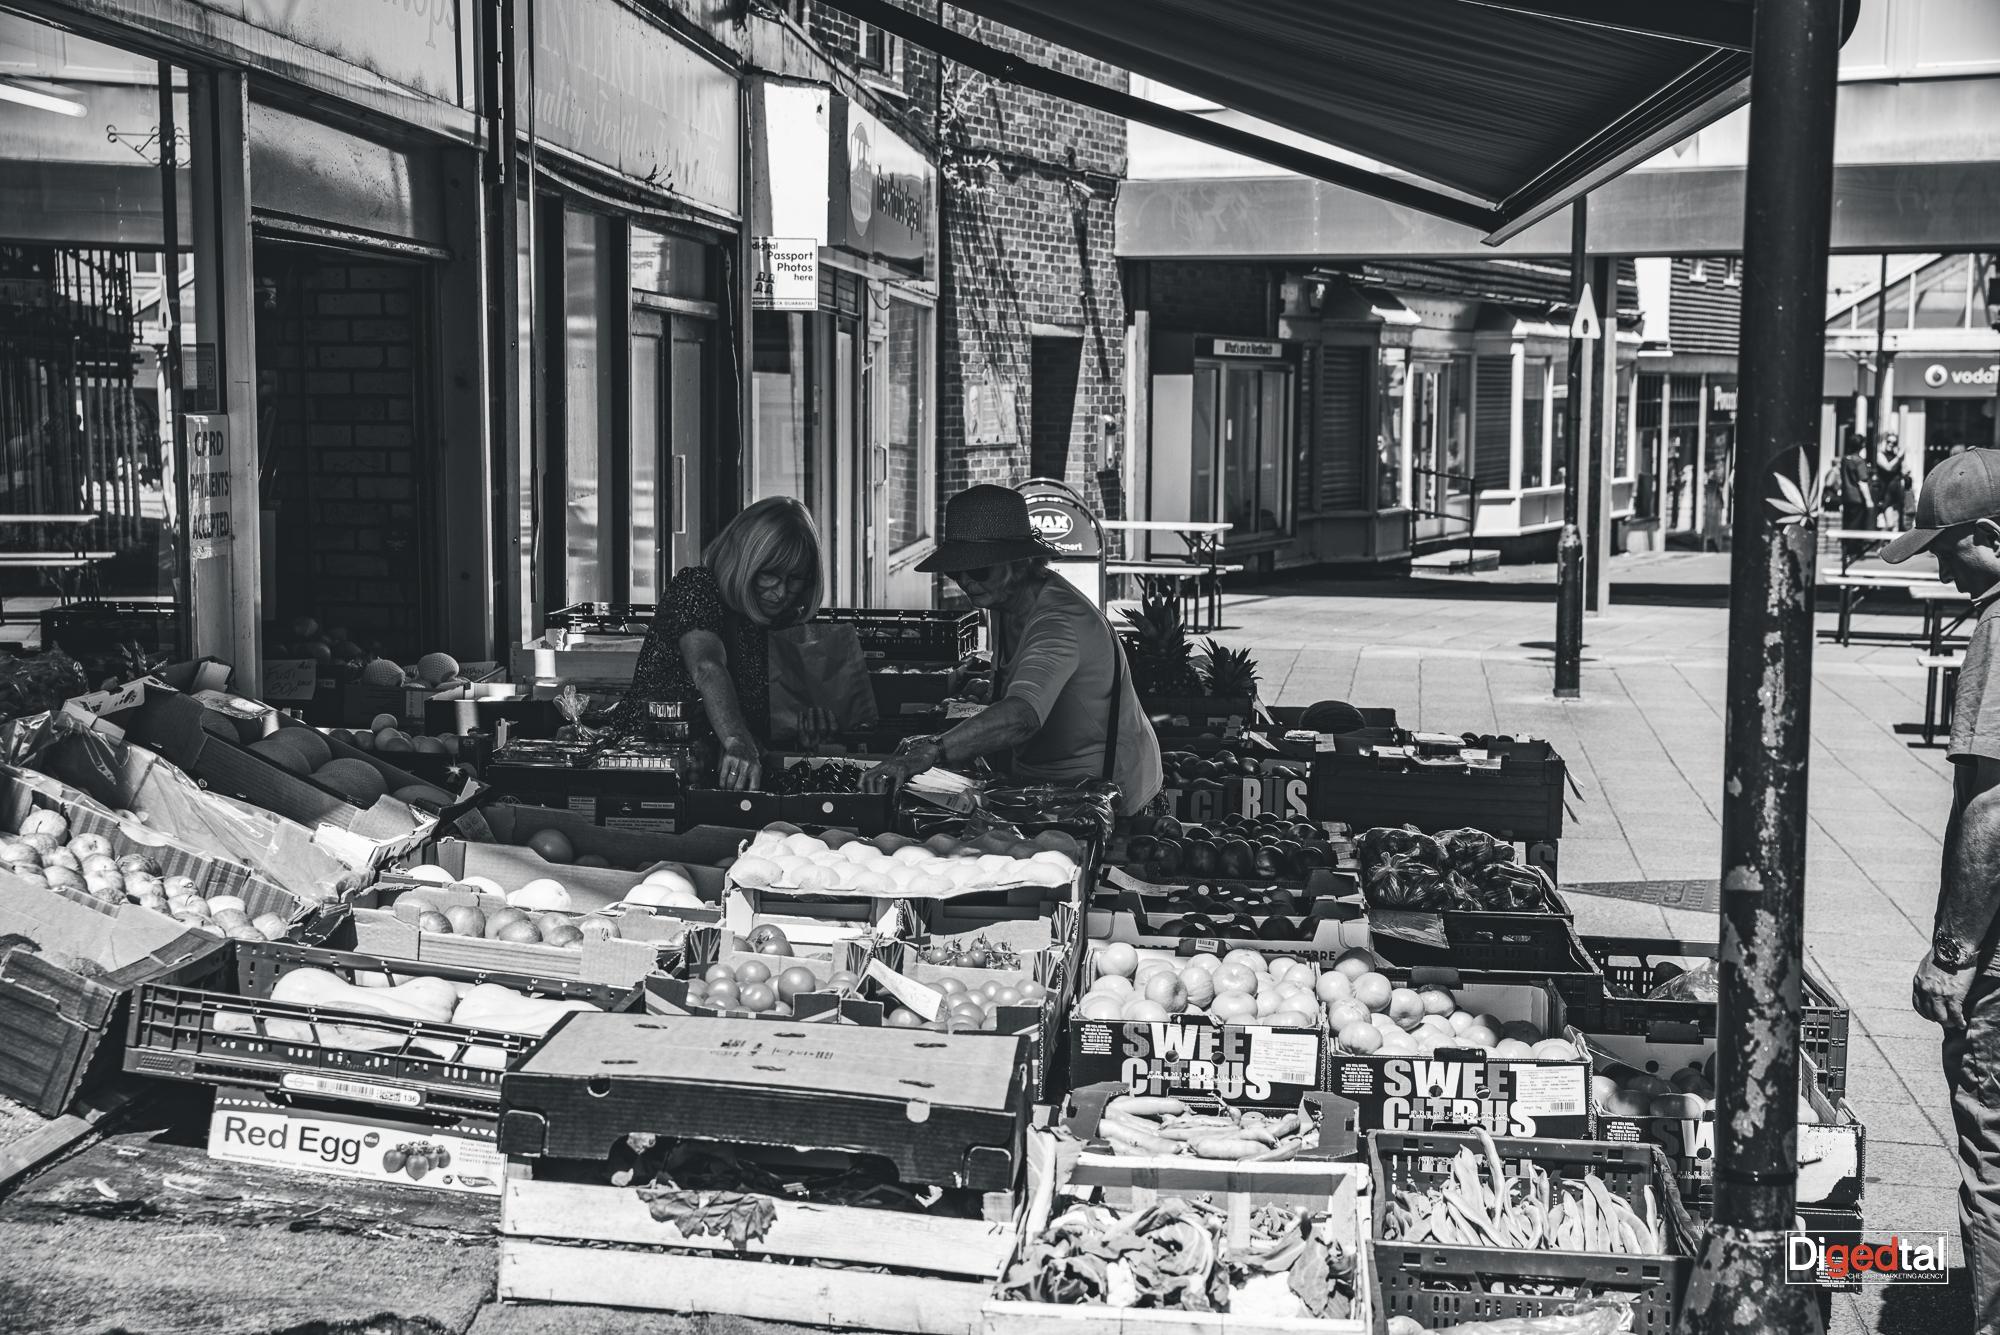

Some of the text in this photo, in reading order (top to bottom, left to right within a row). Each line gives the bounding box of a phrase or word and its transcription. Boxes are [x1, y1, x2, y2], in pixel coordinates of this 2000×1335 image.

[752, 242, 778, 251] digital
[767, 250, 813, 262] Passport
[777, 262, 813, 272] Photos
[794, 273, 813, 281] here
[194, 430, 224, 457] CARD
[190, 471, 229, 498] PAYMENTS
[193, 511, 229, 540] ACCEPTED
[266, 663, 295, 681] FUJI
[1121, 1057, 1271, 1100] CITRUS
[403, 1094, 417, 1103] 136
[1382, 1097, 1537, 1137] CITRUS
[224, 1116, 288, 1150] Red
[298, 1126, 361, 1165] Egg
